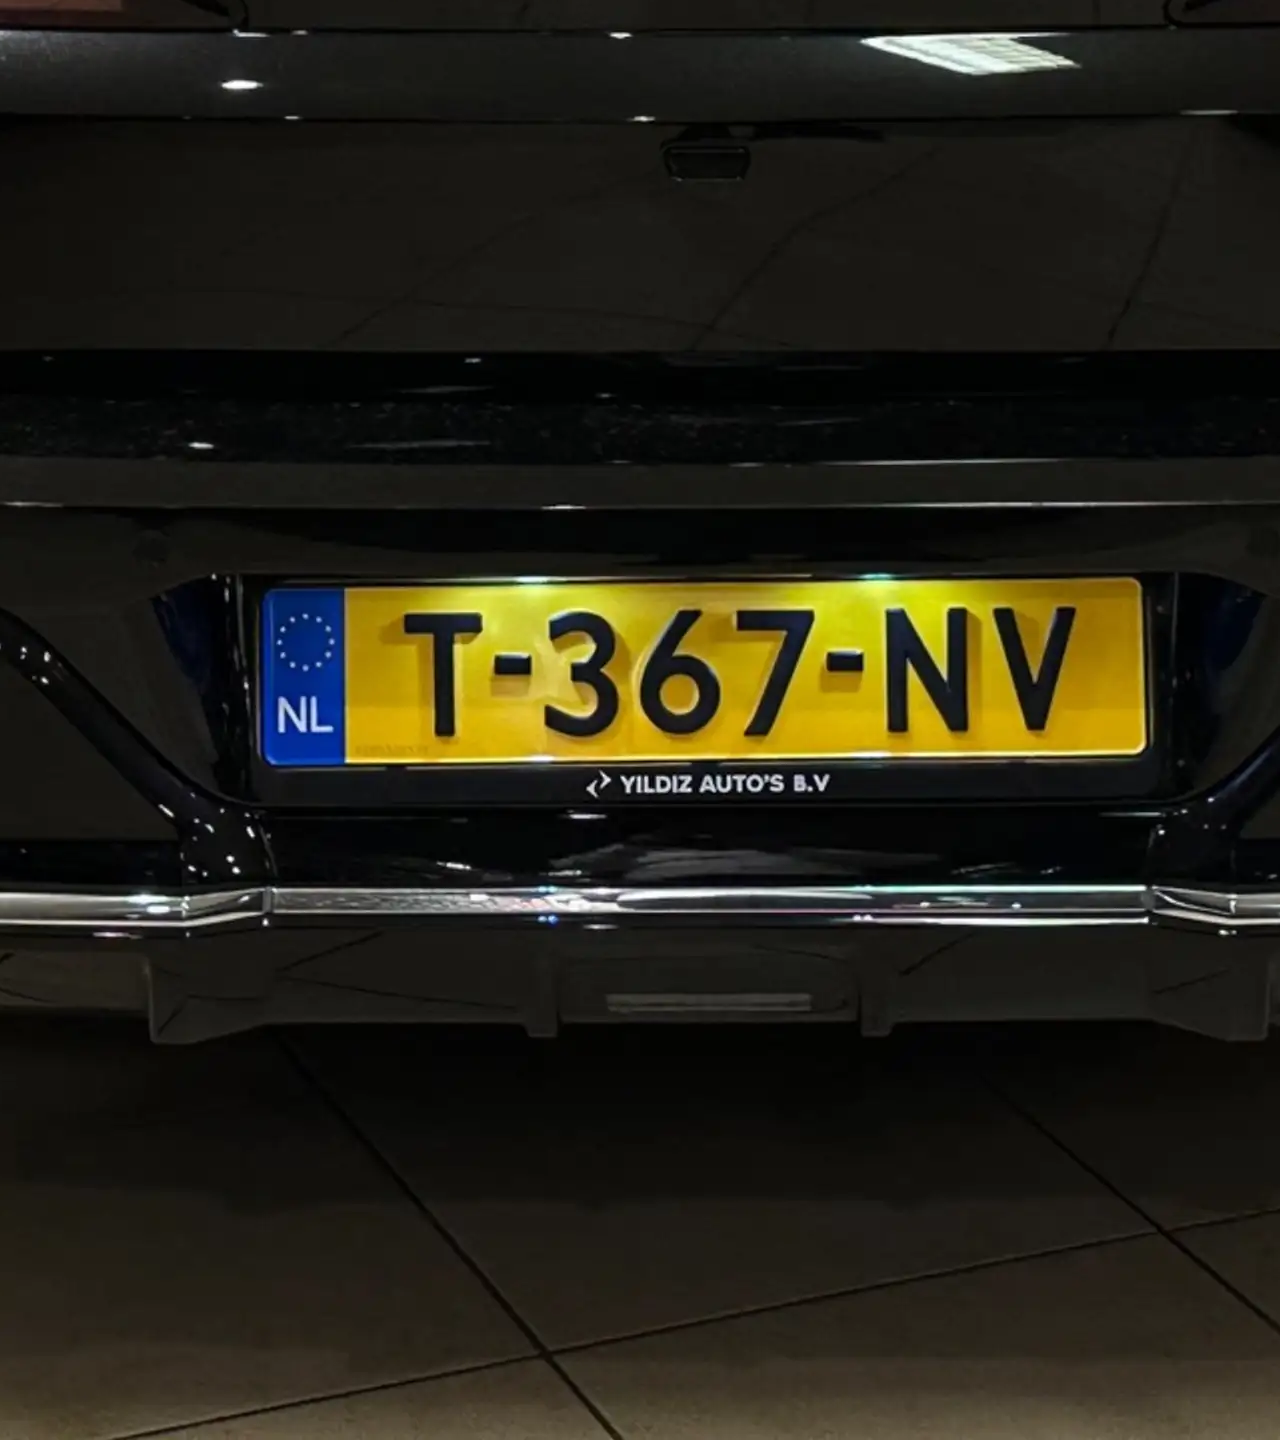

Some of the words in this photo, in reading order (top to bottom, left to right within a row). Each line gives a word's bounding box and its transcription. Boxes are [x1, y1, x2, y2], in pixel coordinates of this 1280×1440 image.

[404, 606, 1077, 738] T-367-NV
[277, 695, 334, 734] NL
[620, 774, 693, 794] YILDIZ
[698, 773, 785, 794] AUTO'S
